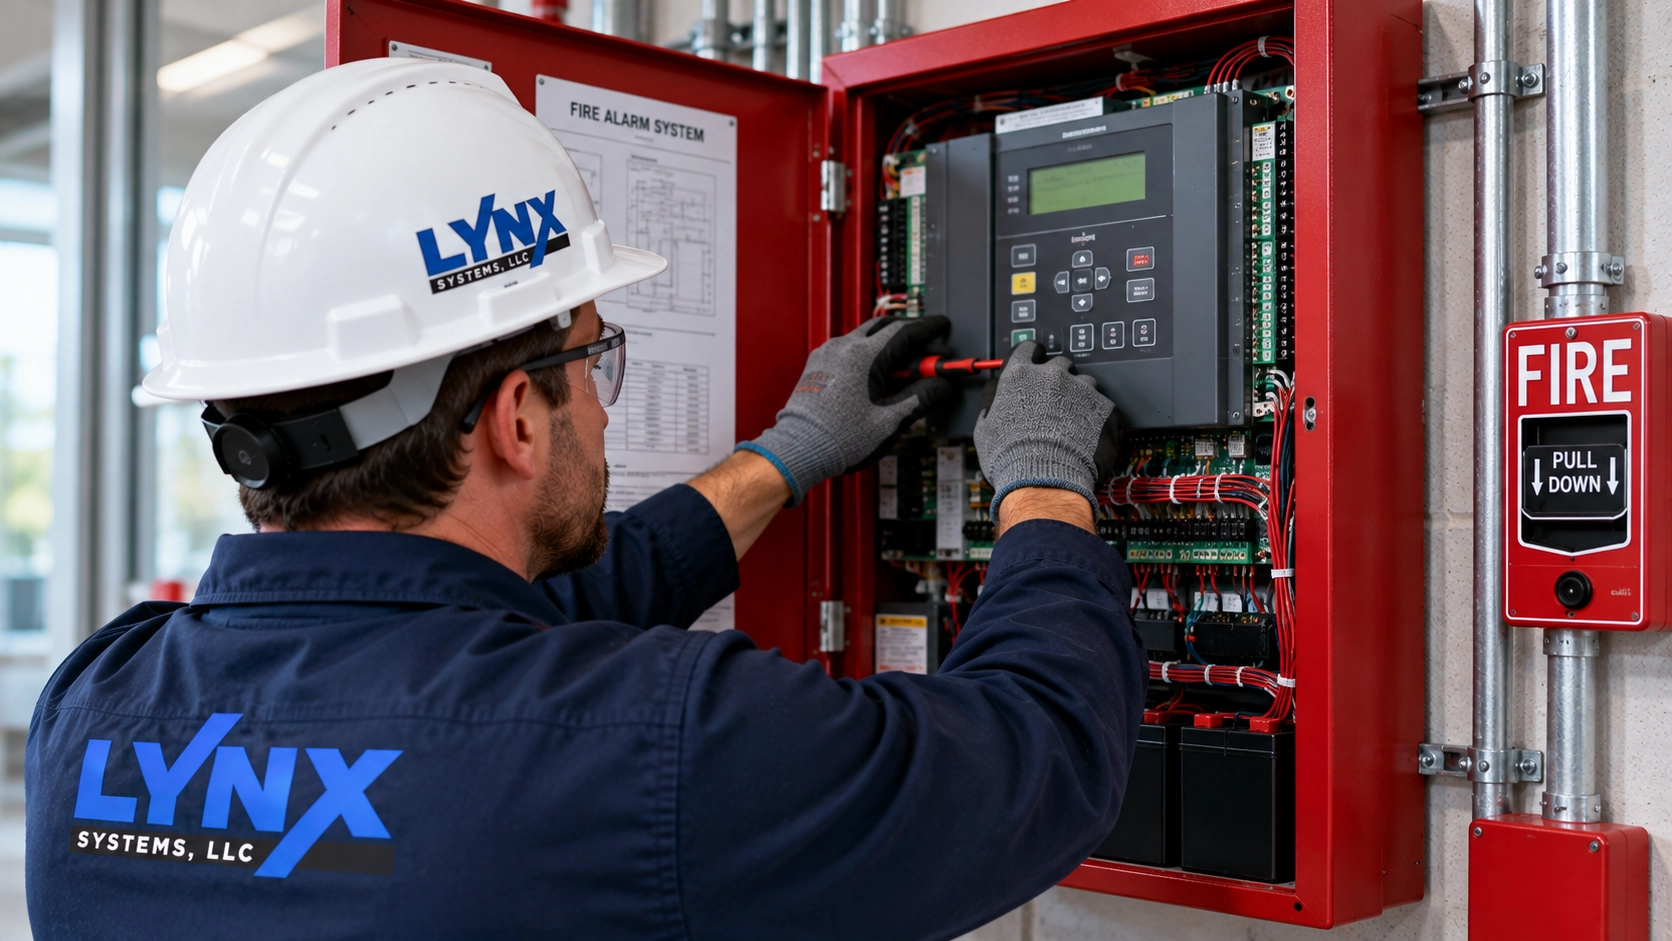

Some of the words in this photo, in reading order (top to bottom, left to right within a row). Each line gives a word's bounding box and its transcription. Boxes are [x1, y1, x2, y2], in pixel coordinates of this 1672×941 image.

[570, 101, 600, 121] FIRE
[604, 109, 650, 131] ALARM
[654, 119, 705, 142] SYSTEM
[416, 189, 567, 269] LYNX
[436, 261, 505, 290] SYSTEMS,
[508, 252, 529, 267] LLC
[1518, 338, 1632, 407] FIRE
[1552, 451, 1597, 469] PULL
[1548, 475, 1601, 494] DOWN
[74, 713, 404, 878] LYNX
[76, 830, 195, 862] SYSTEMS,
[206, 839, 254, 863] LLC
